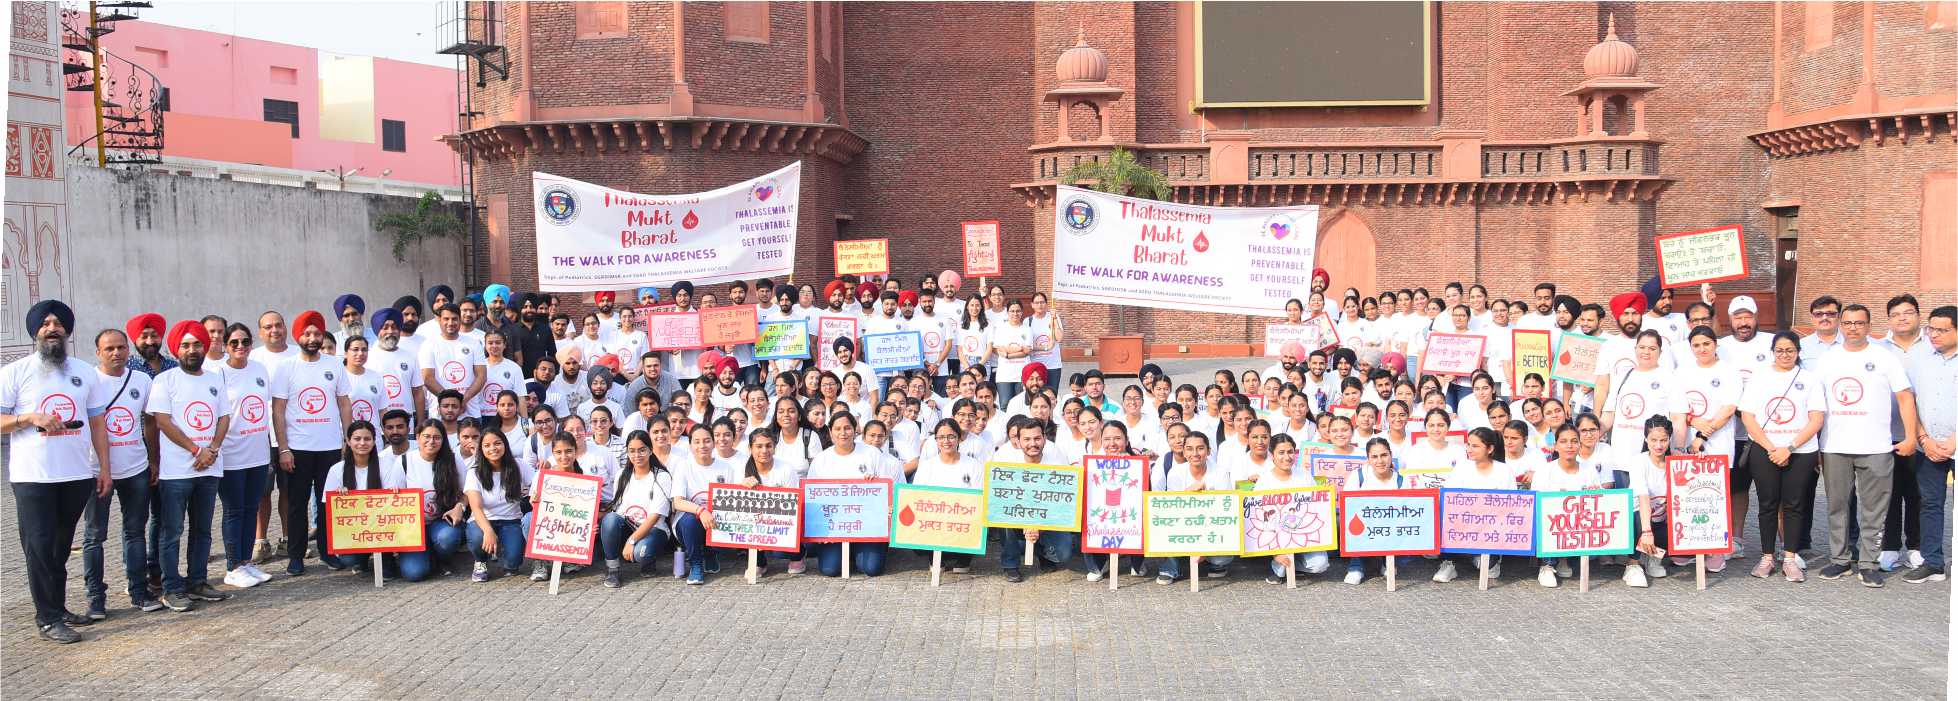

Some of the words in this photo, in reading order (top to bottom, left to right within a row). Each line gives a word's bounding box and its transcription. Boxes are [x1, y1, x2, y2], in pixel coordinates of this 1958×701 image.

[627, 210, 673, 227] Mukt
[735, 205, 786, 219] THALASSEMIA
[788, 204, 794, 213] IS
[1119, 200, 1211, 224] Thalassemia
[621, 229, 678, 248] Bharat
[742, 237, 755, 247] GET
[757, 234, 792, 245] YOURSELF
[1141, 224, 1184, 243] Mukt
[756, 249, 782, 260] TESTED
[1134, 245, 1188, 265] Bharat
[1248, 244, 1301, 255] THALASSEMIA
[552, 256, 575, 267] THE
[579, 255, 615, 266] WALK
[618, 254, 640, 265] FOR
[644, 248, 717, 263] AWARENESS
[1066, 264, 1086, 275] THE
[1090, 266, 1123, 279] WALK
[1126, 269, 1149, 280] FOR
[1152, 272, 1224, 287] AWARENESS
[1250, 273, 1263, 282] GET
[1266, 275, 1305, 285] YOURSELF
[1264, 288, 1292, 298] TESTED
[1522, 355, 1548, 368] BETTER
[1096, 459, 1130, 469] WORLD
[1691, 458, 1724, 474] STOP
[1311, 490, 1329, 502] LIFE
[543, 501, 554, 512] To
[1003, 503, 1048, 519] ਪਰਿਵਾਰ
[1563, 494, 1603, 514] GET
[717, 521, 754, 533] OGETHER
[766, 525, 789, 536] LIMIT
[1547, 510, 1620, 532] YOURSELF
[351, 529, 395, 543] ਪਰਿਵਾਰ
[729, 533, 746, 542] THE
[748, 534, 777, 544] SPREAD
[1367, 526, 1391, 539] ਮੁਕਤ
[1551, 529, 1611, 549] TESTED
[1101, 536, 1124, 548] DAY
